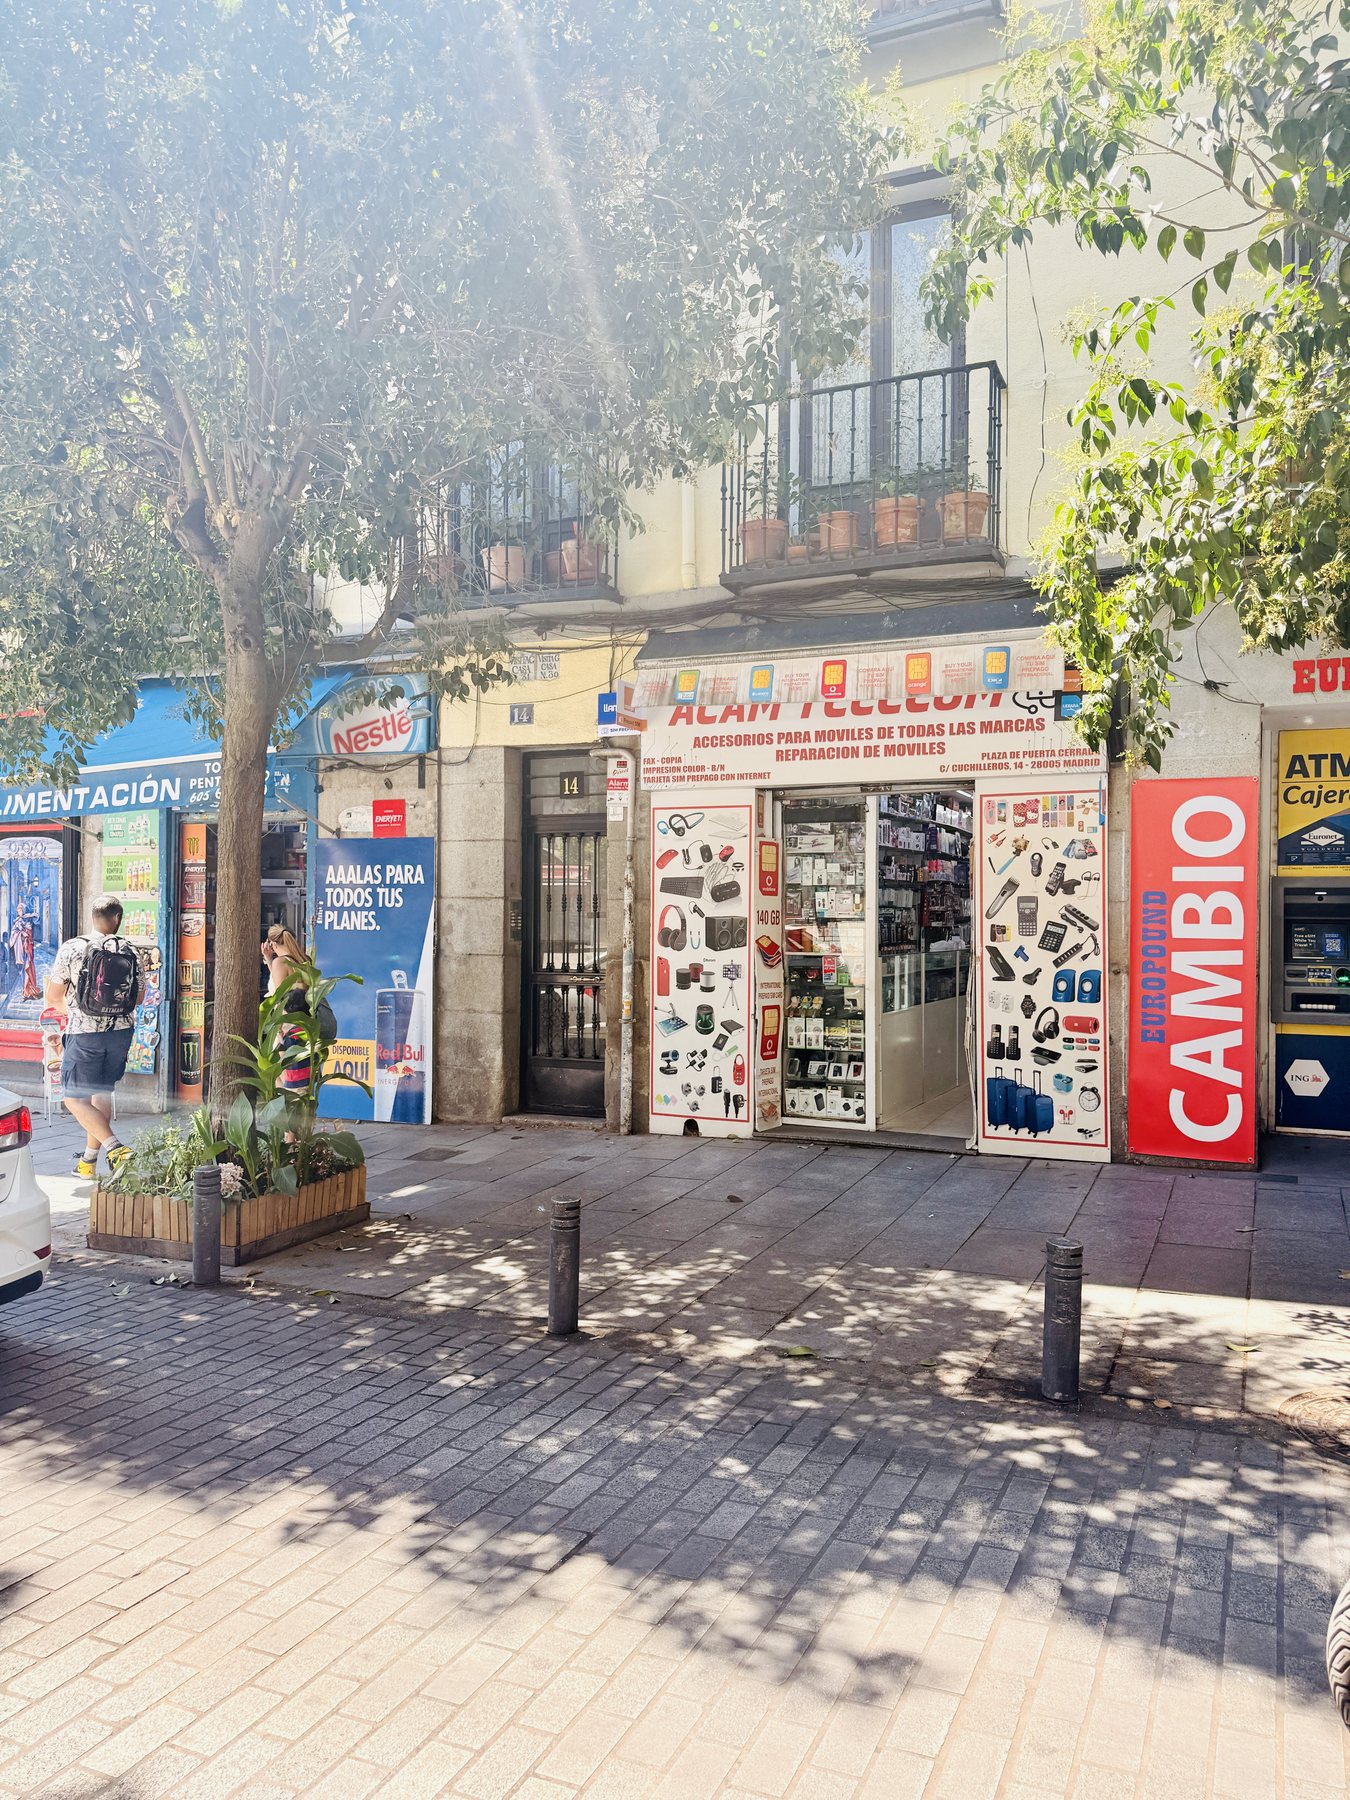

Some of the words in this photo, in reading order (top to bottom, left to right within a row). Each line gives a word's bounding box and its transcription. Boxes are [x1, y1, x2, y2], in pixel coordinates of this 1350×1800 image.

[541, 663, 557, 671] CASA
[513, 707, 530, 723] 14
[333, 710, 413, 754] Nestlé
[693, 732, 774, 749] ACCESORIOS
[777, 730, 811, 745] PARA
[814, 727, 873, 743] MOVILES
[877, 725, 894, 740] DE
[898, 723, 945, 739] TODAS
[949, 721, 976, 736] LAS
[979, 717, 1046, 735] MARCAS
[643, 757, 656, 765] FAX
[661, 756, 682, 765] COPIA
[775, 746, 860, 762] REPARACION
[863, 744, 880, 758] DE
[883, 741, 946, 758] MOVILES
[981, 752, 1008, 761] PLAZA
[1009, 751, 1021, 759] DE
[1022, 749, 1056, 759] PUERTA
[643, 766, 682, 775] IMPRESION
[682, 764, 706, 773] COLOR
[711, 764, 725, 772] B/N
[939, 764, 949, 773] C/
[951, 763, 1011, 773] CUCHILLEROS,
[1013, 762, 1023, 770] 14
[1030, 760, 1061, 769] 28005
[1063, 758, 1100, 768] MADRID
[190, 776, 221, 790] PENT
[563, 776, 579, 794] 14
[643, 775, 671, 784] TARJETA
[672, 775, 686, 783] SIM
[686, 774, 719, 782] PREPAGO
[720, 773, 736, 781] CON
[736, 772, 772, 781] INTERNET
[0, 774, 181, 817] IMENTACIÓN
[190, 791, 210, 803] 605
[1282, 784, 1350, 809] Cajer
[325, 865, 382, 885] AAALAS
[386, 864, 425, 884] PARA
[325, 887, 373, 908] TODOS
[377, 887, 404, 908] TUS
[324, 910, 381, 931] PLANES.
[756, 910, 768, 925] 140
[770, 910, 780, 925] GB
[1140, 890, 1167, 1044] EUROPOUND
[1169, 795, 1246, 1143] CAMBIO
[332, 1045, 369, 1056] DISPONIBLE
[376, 1043, 400, 1061] Red
[403, 1044, 424, 1061] Bull
[333, 1057, 370, 1081] AQUÍ
[1290, 1074, 1310, 1082] ING
